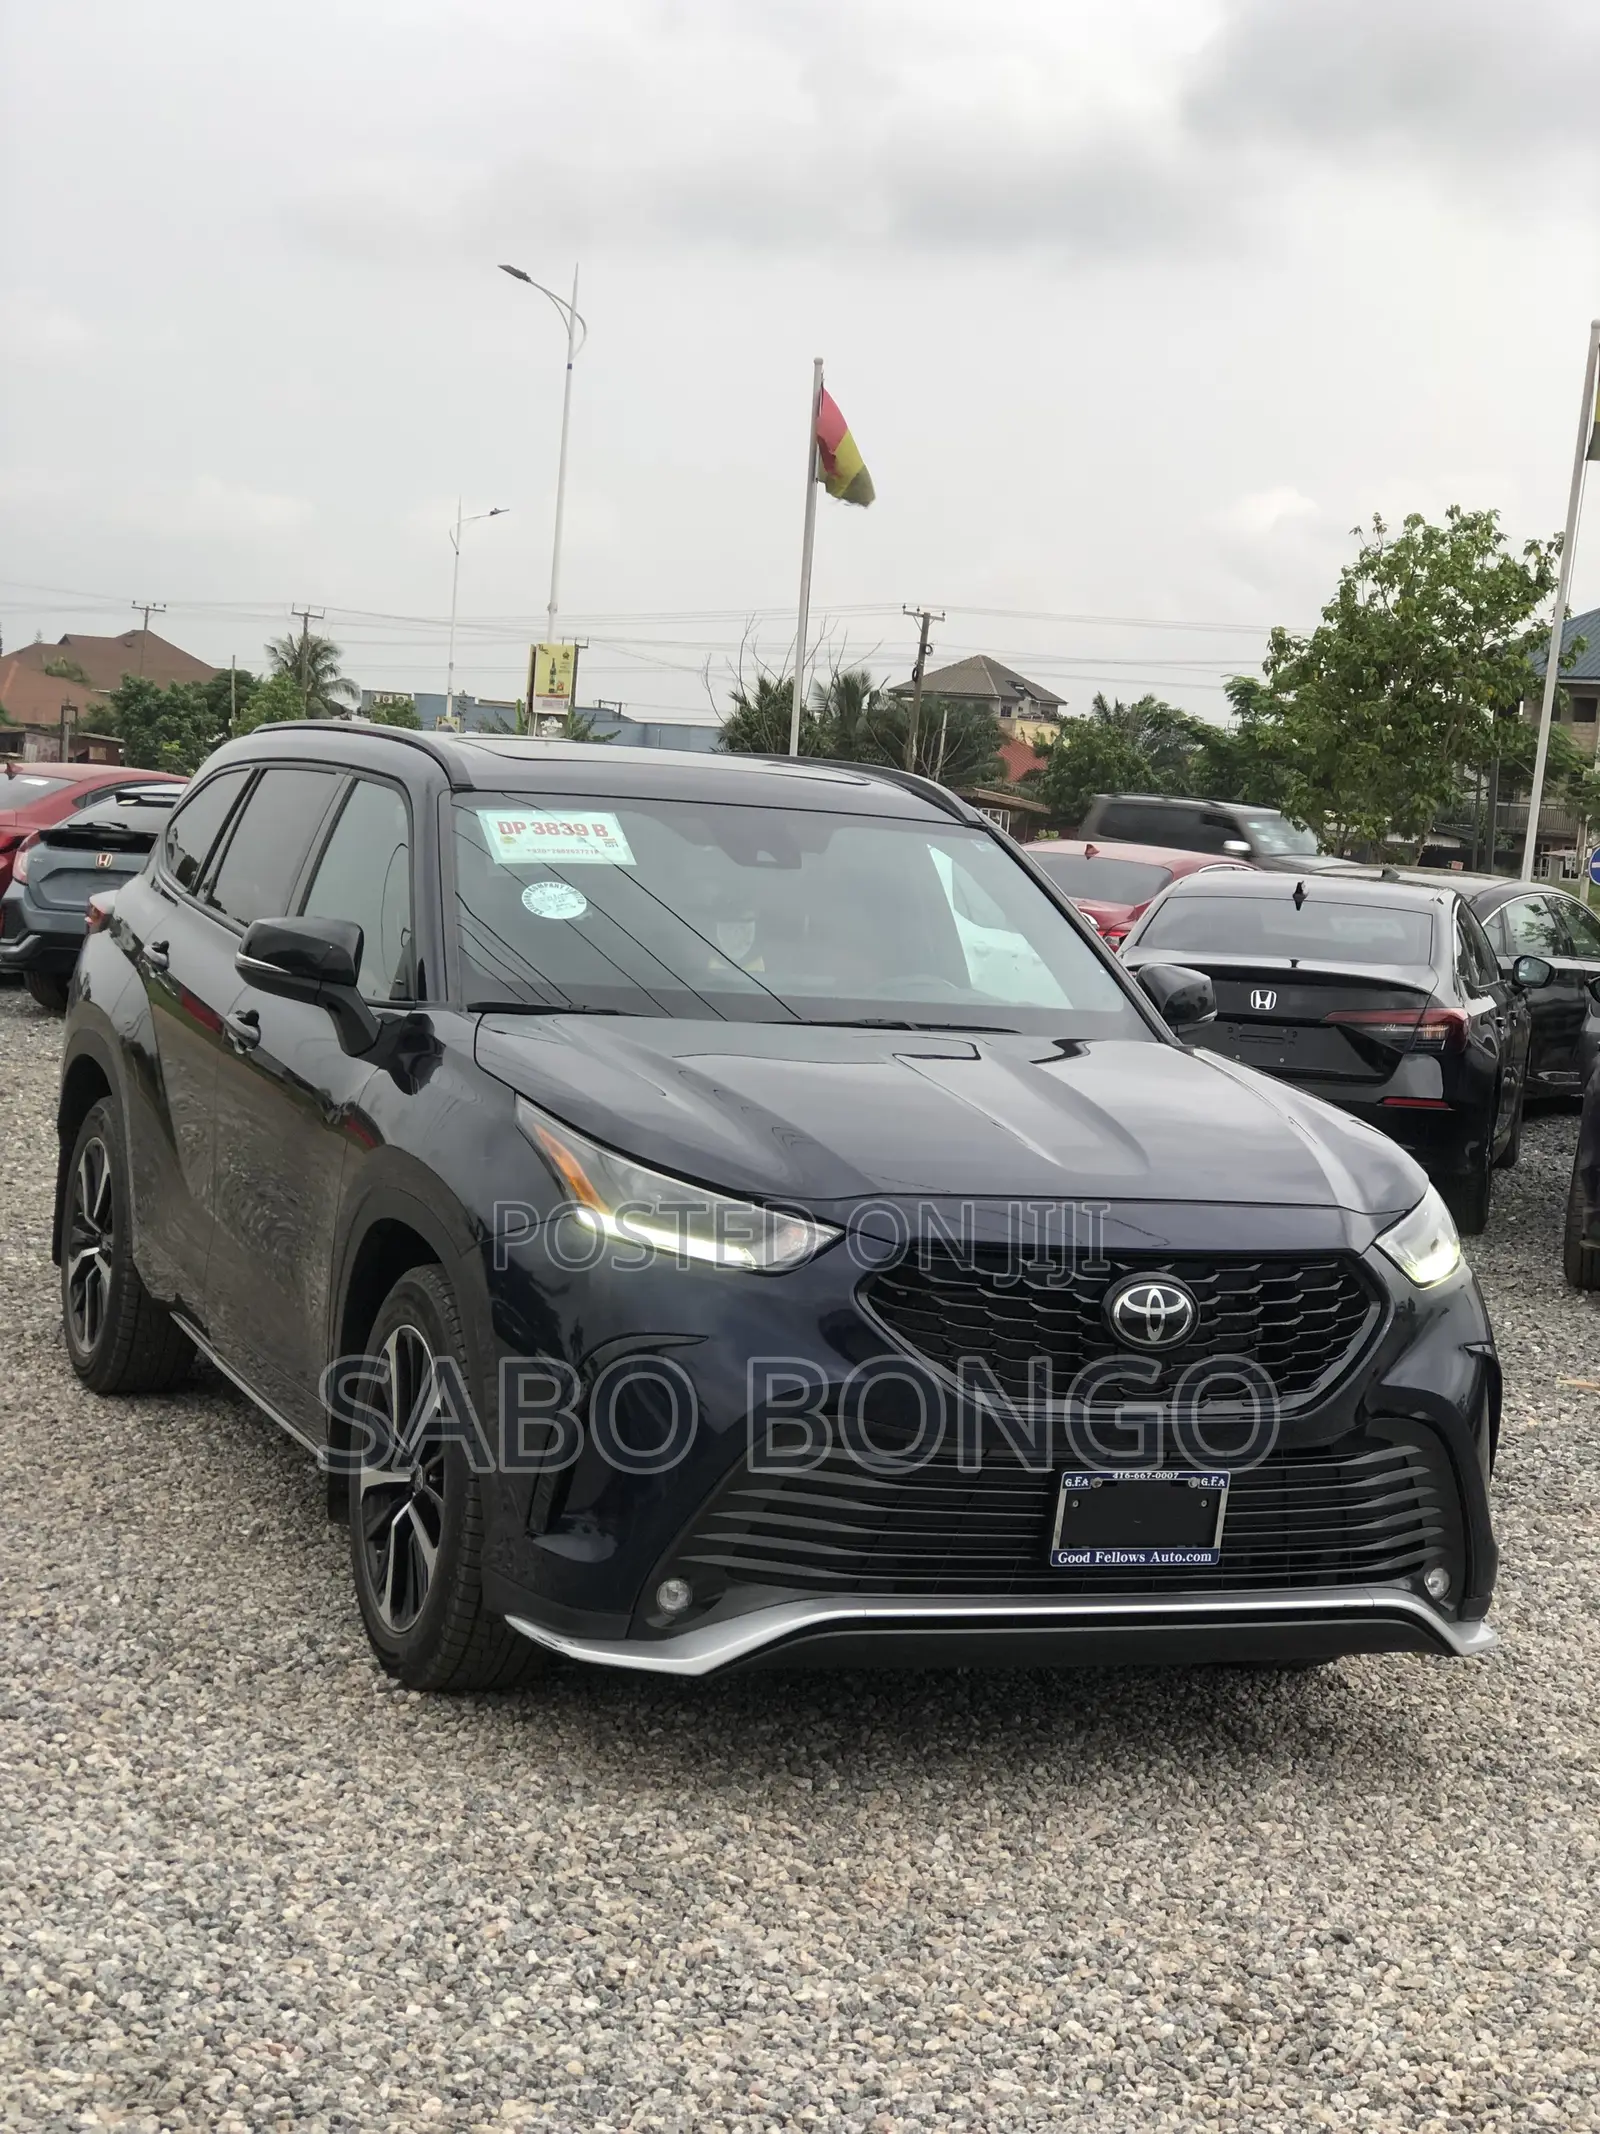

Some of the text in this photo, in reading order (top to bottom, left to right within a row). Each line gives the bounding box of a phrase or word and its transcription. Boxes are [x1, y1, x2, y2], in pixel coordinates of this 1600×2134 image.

[497, 821, 609, 837] DP 3839 B
[1057, 1551, 1212, 1563] Good Fellows Auto.com
